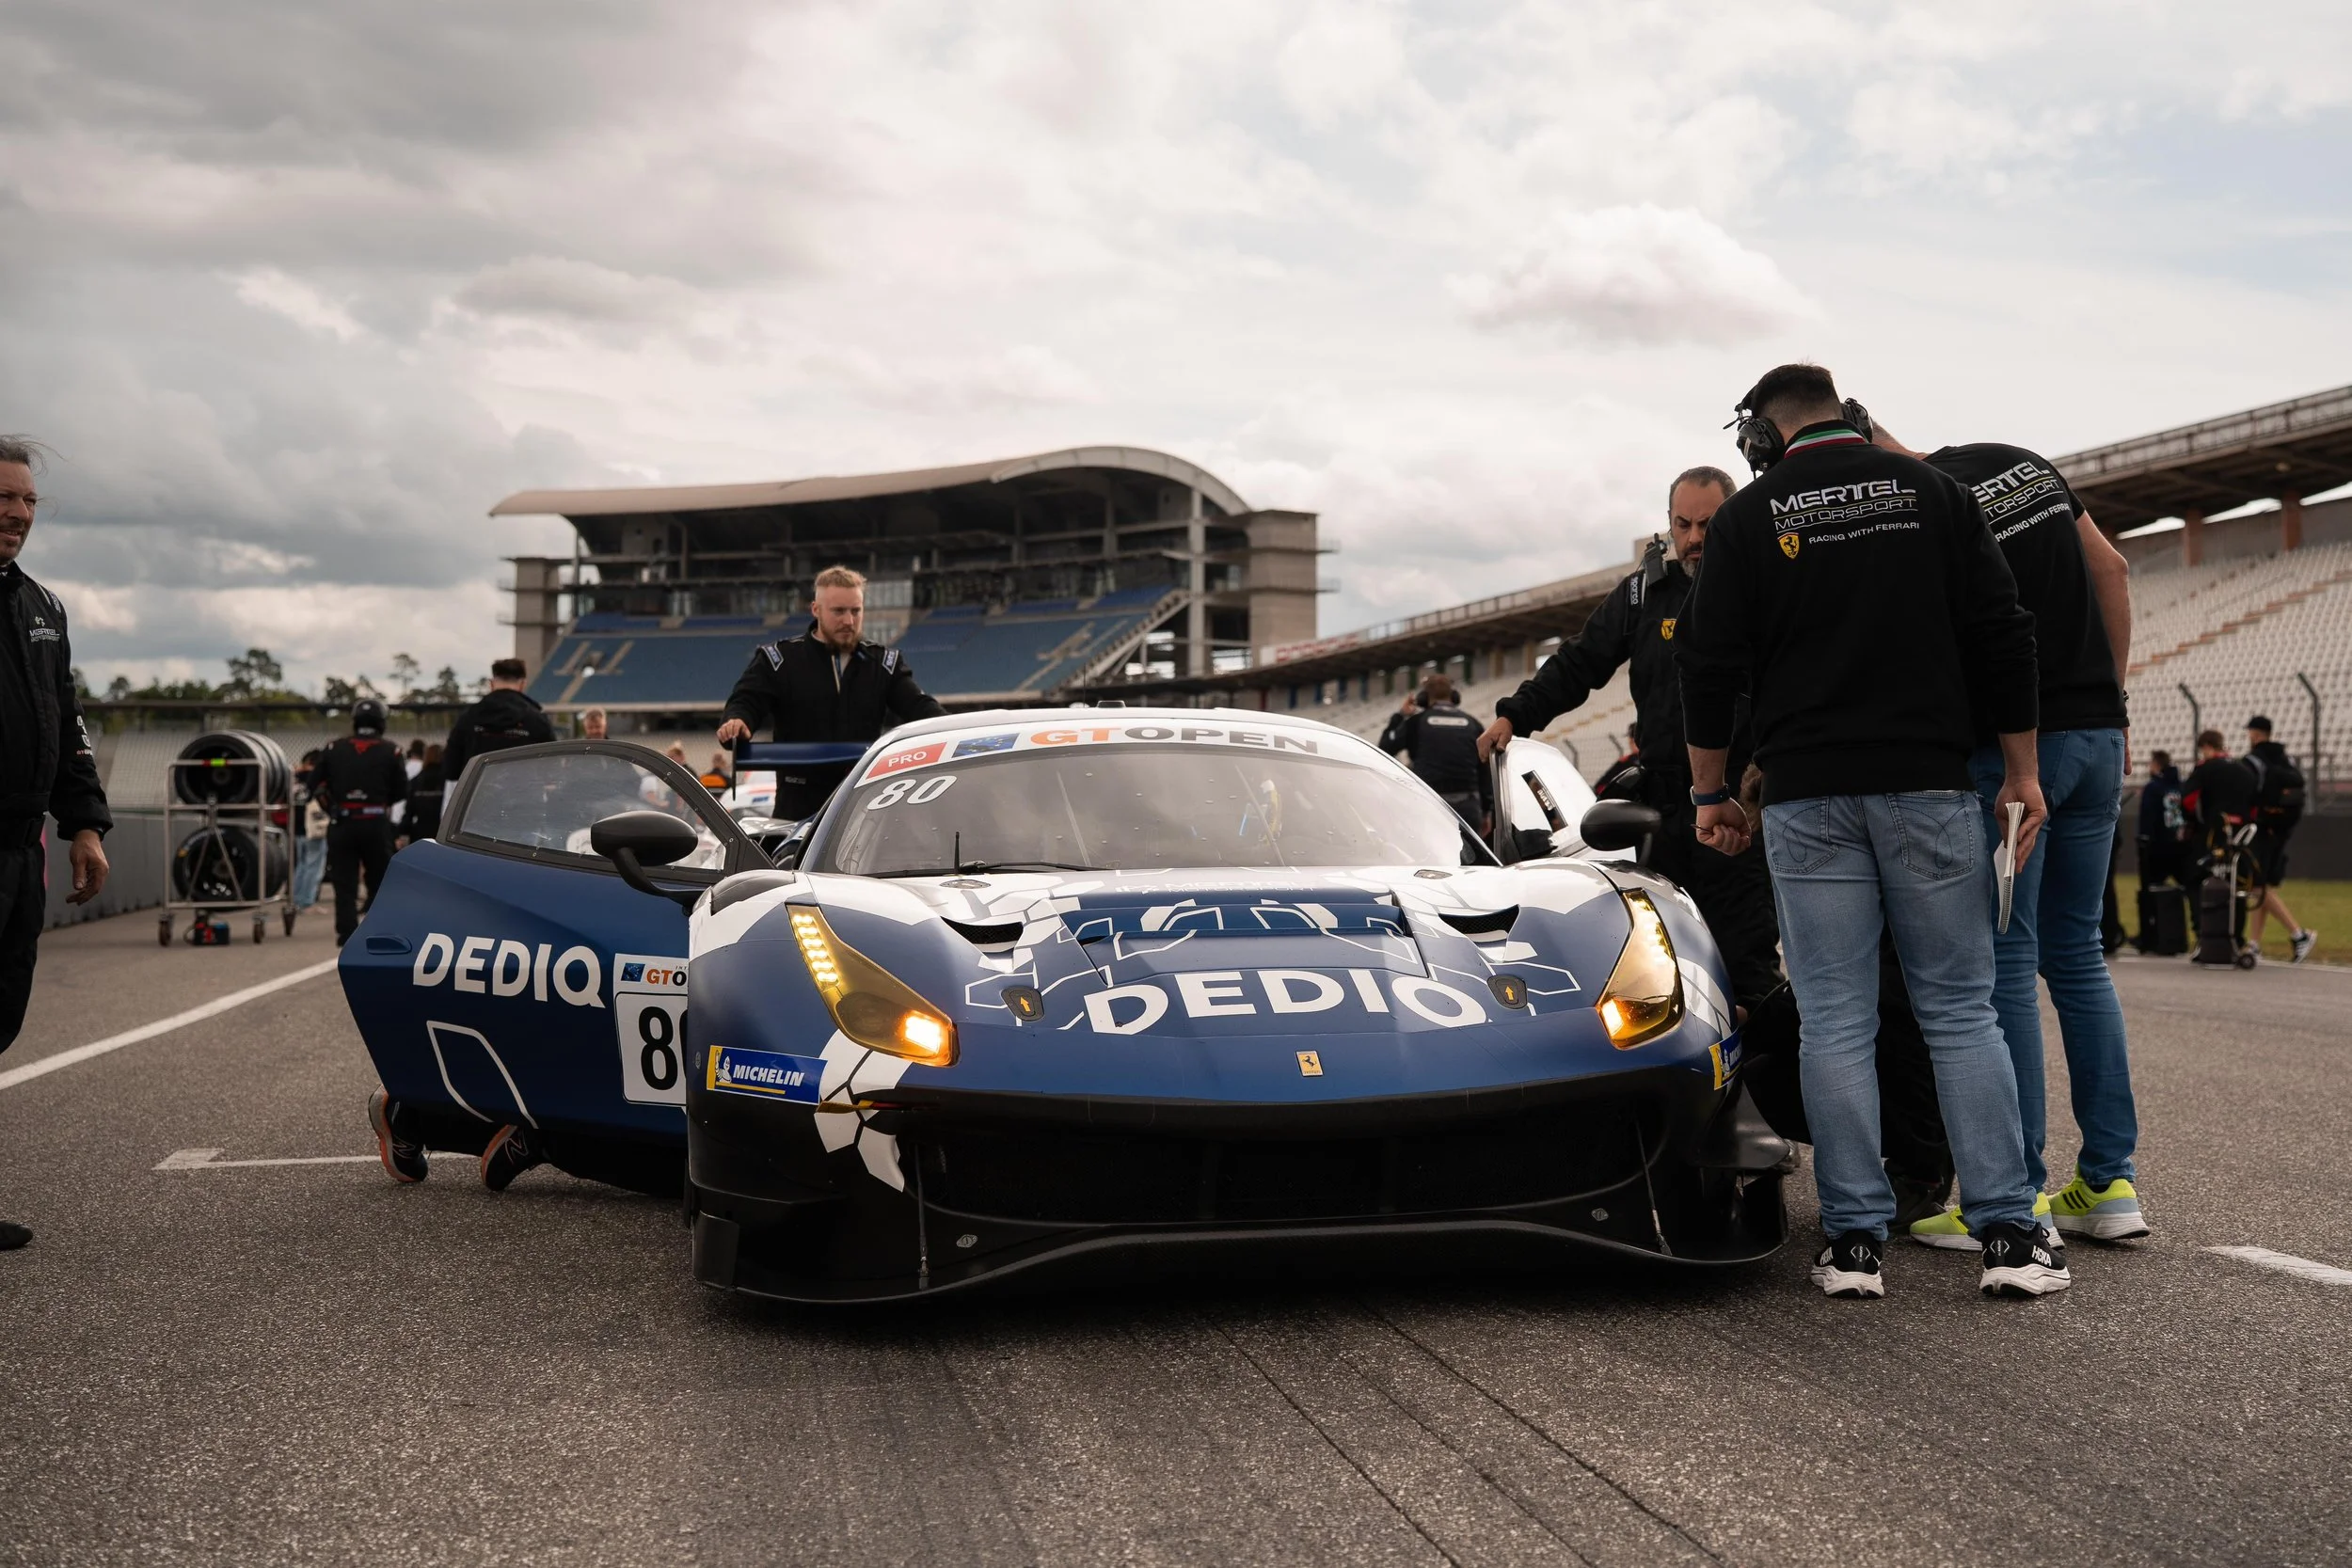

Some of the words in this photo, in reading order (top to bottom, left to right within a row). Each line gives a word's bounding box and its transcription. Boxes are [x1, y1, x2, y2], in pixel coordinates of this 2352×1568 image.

[1770, 479, 1916, 515] MERTEL
[1971, 461, 2051, 503] ERTEL
[1984, 479, 2060, 517] TORSPORT
[1774, 499, 1917, 531] MOTORSPORT
[1994, 520, 2030, 543] RACING
[2027, 510, 2050, 526] WITH
[1808, 533, 1846, 545] RACING
[1848, 526, 1874, 539] WITH
[1875, 522, 1920, 532] FERRARI
[888, 751, 927, 768] PRO
[866, 775, 958, 810] 80
[413, 932, 606, 1008] DEDIQ
[646, 968, 688, 987] GTO
[638, 1006, 688, 1091] 8
[733, 1064, 805, 1086] MICHELIN
[2032, 1244, 2052, 1266] HOKA
